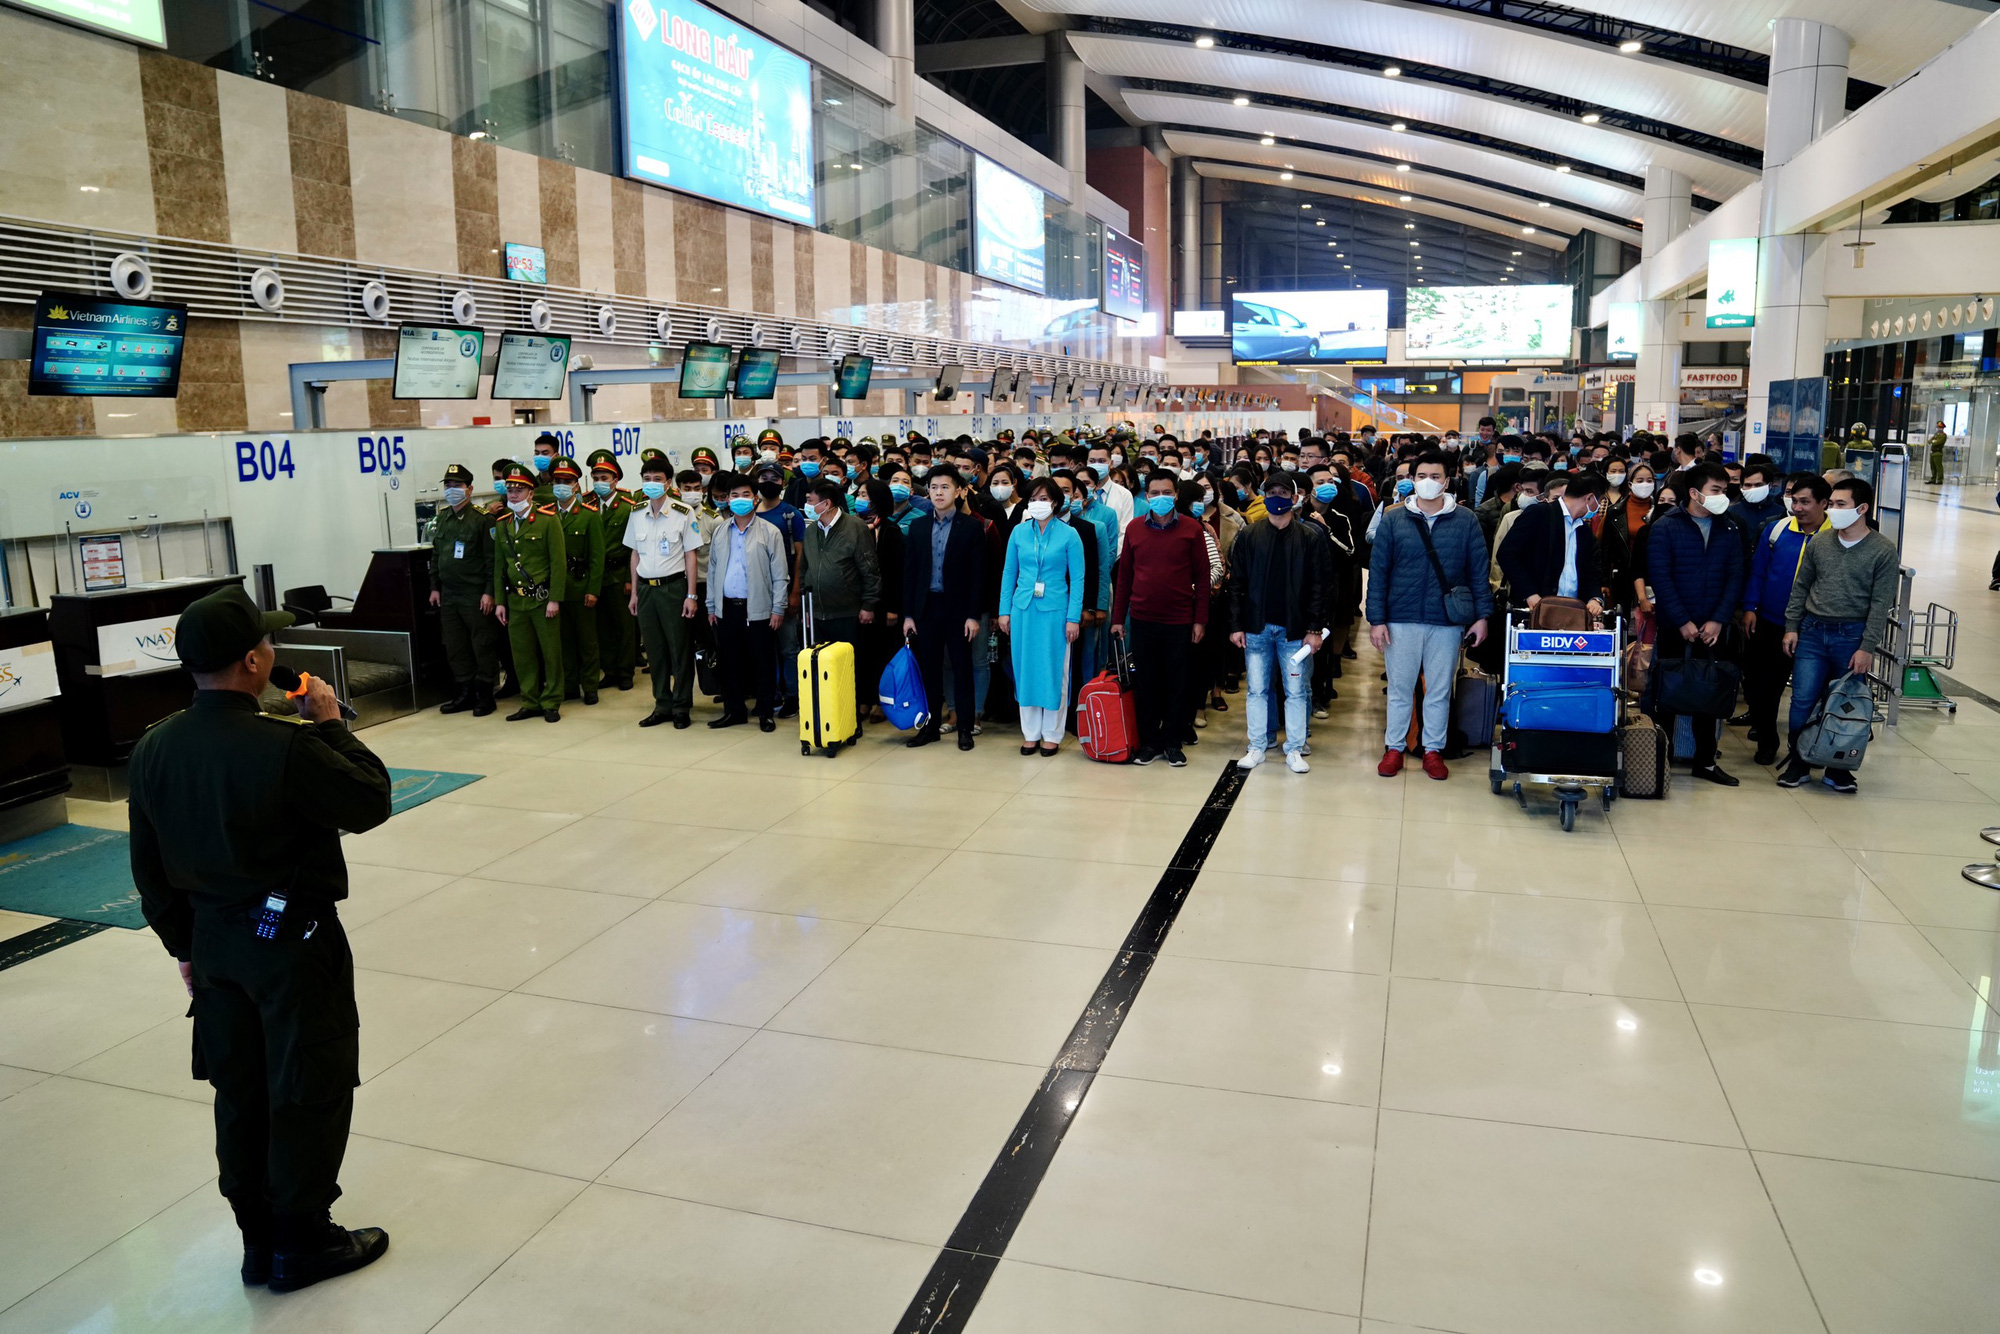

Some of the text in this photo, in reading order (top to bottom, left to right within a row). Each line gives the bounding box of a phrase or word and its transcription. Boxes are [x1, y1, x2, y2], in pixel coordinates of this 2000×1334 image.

[661, 8, 711, 64] LONG
[69, 310, 148, 326] Vietnam Airlines
[1610, 374, 1635, 382] LUCK
[1687, 373, 1738, 382] FASTFOOD
[837, 420, 853, 438] B09
[927, 419, 939, 436] B11
[541, 430, 575, 459] 06
[612, 427, 641, 456] B07
[236, 439, 296, 482] B04
[358, 436, 406, 473] B05
[60, 491, 80, 499] ACV
[136, 633, 167, 648] VNA
[1541, 636, 1574, 649] BIDV
